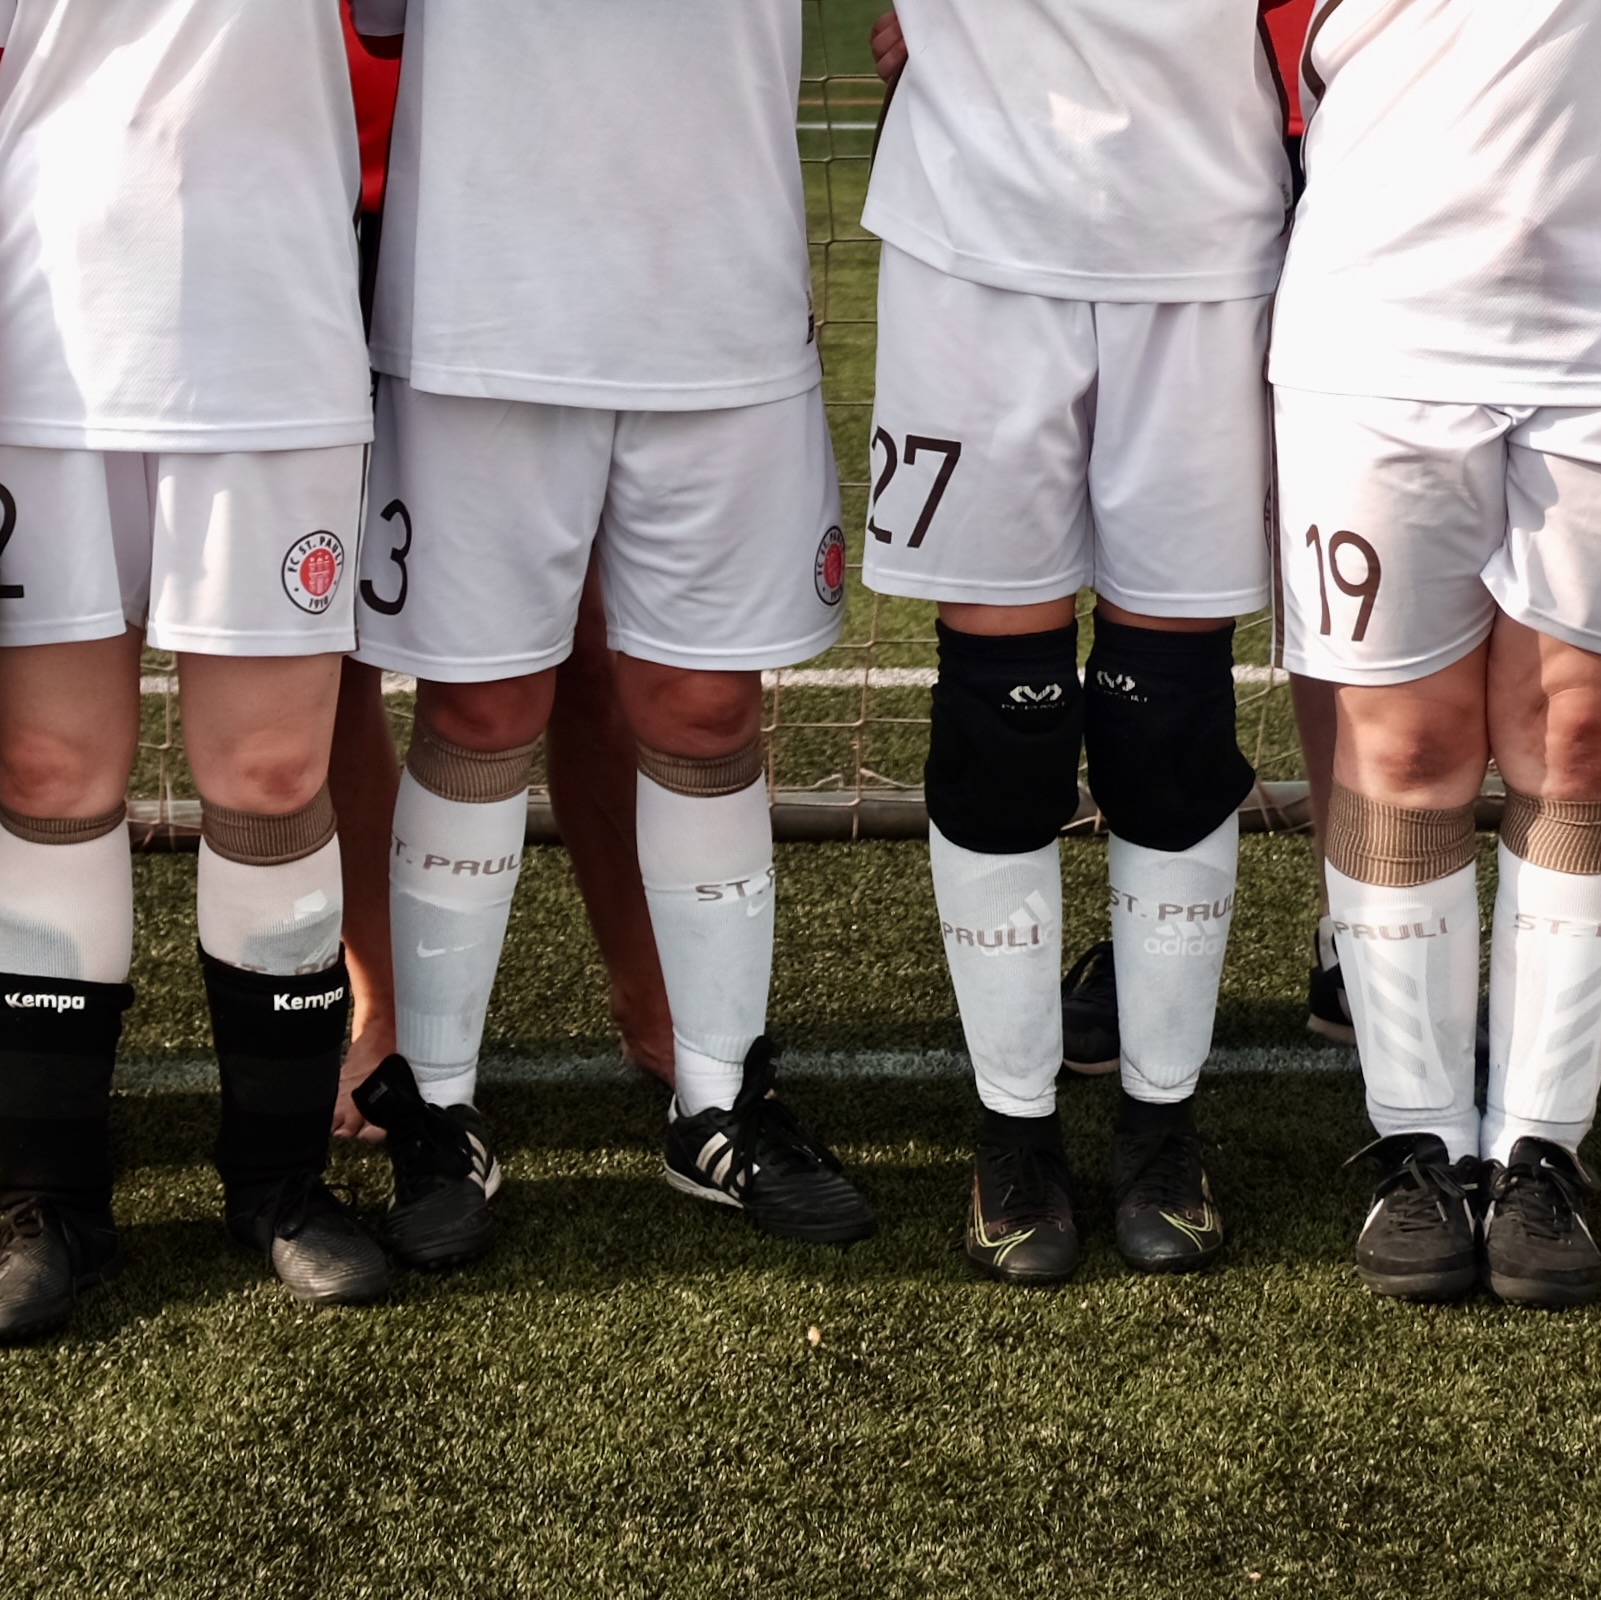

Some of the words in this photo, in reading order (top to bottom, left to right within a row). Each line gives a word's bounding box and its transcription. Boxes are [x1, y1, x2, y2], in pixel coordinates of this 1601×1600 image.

[868, 425, 962, 548] 27
[359, 498, 412, 616] 3
[1306, 524, 1381, 642] 19
[941, 920, 1039, 948] PAULI
[1332, 917, 1448, 942] PAULI
[4, 992, 85, 1013] Kempa
[273, 986, 344, 1011] Kempa
